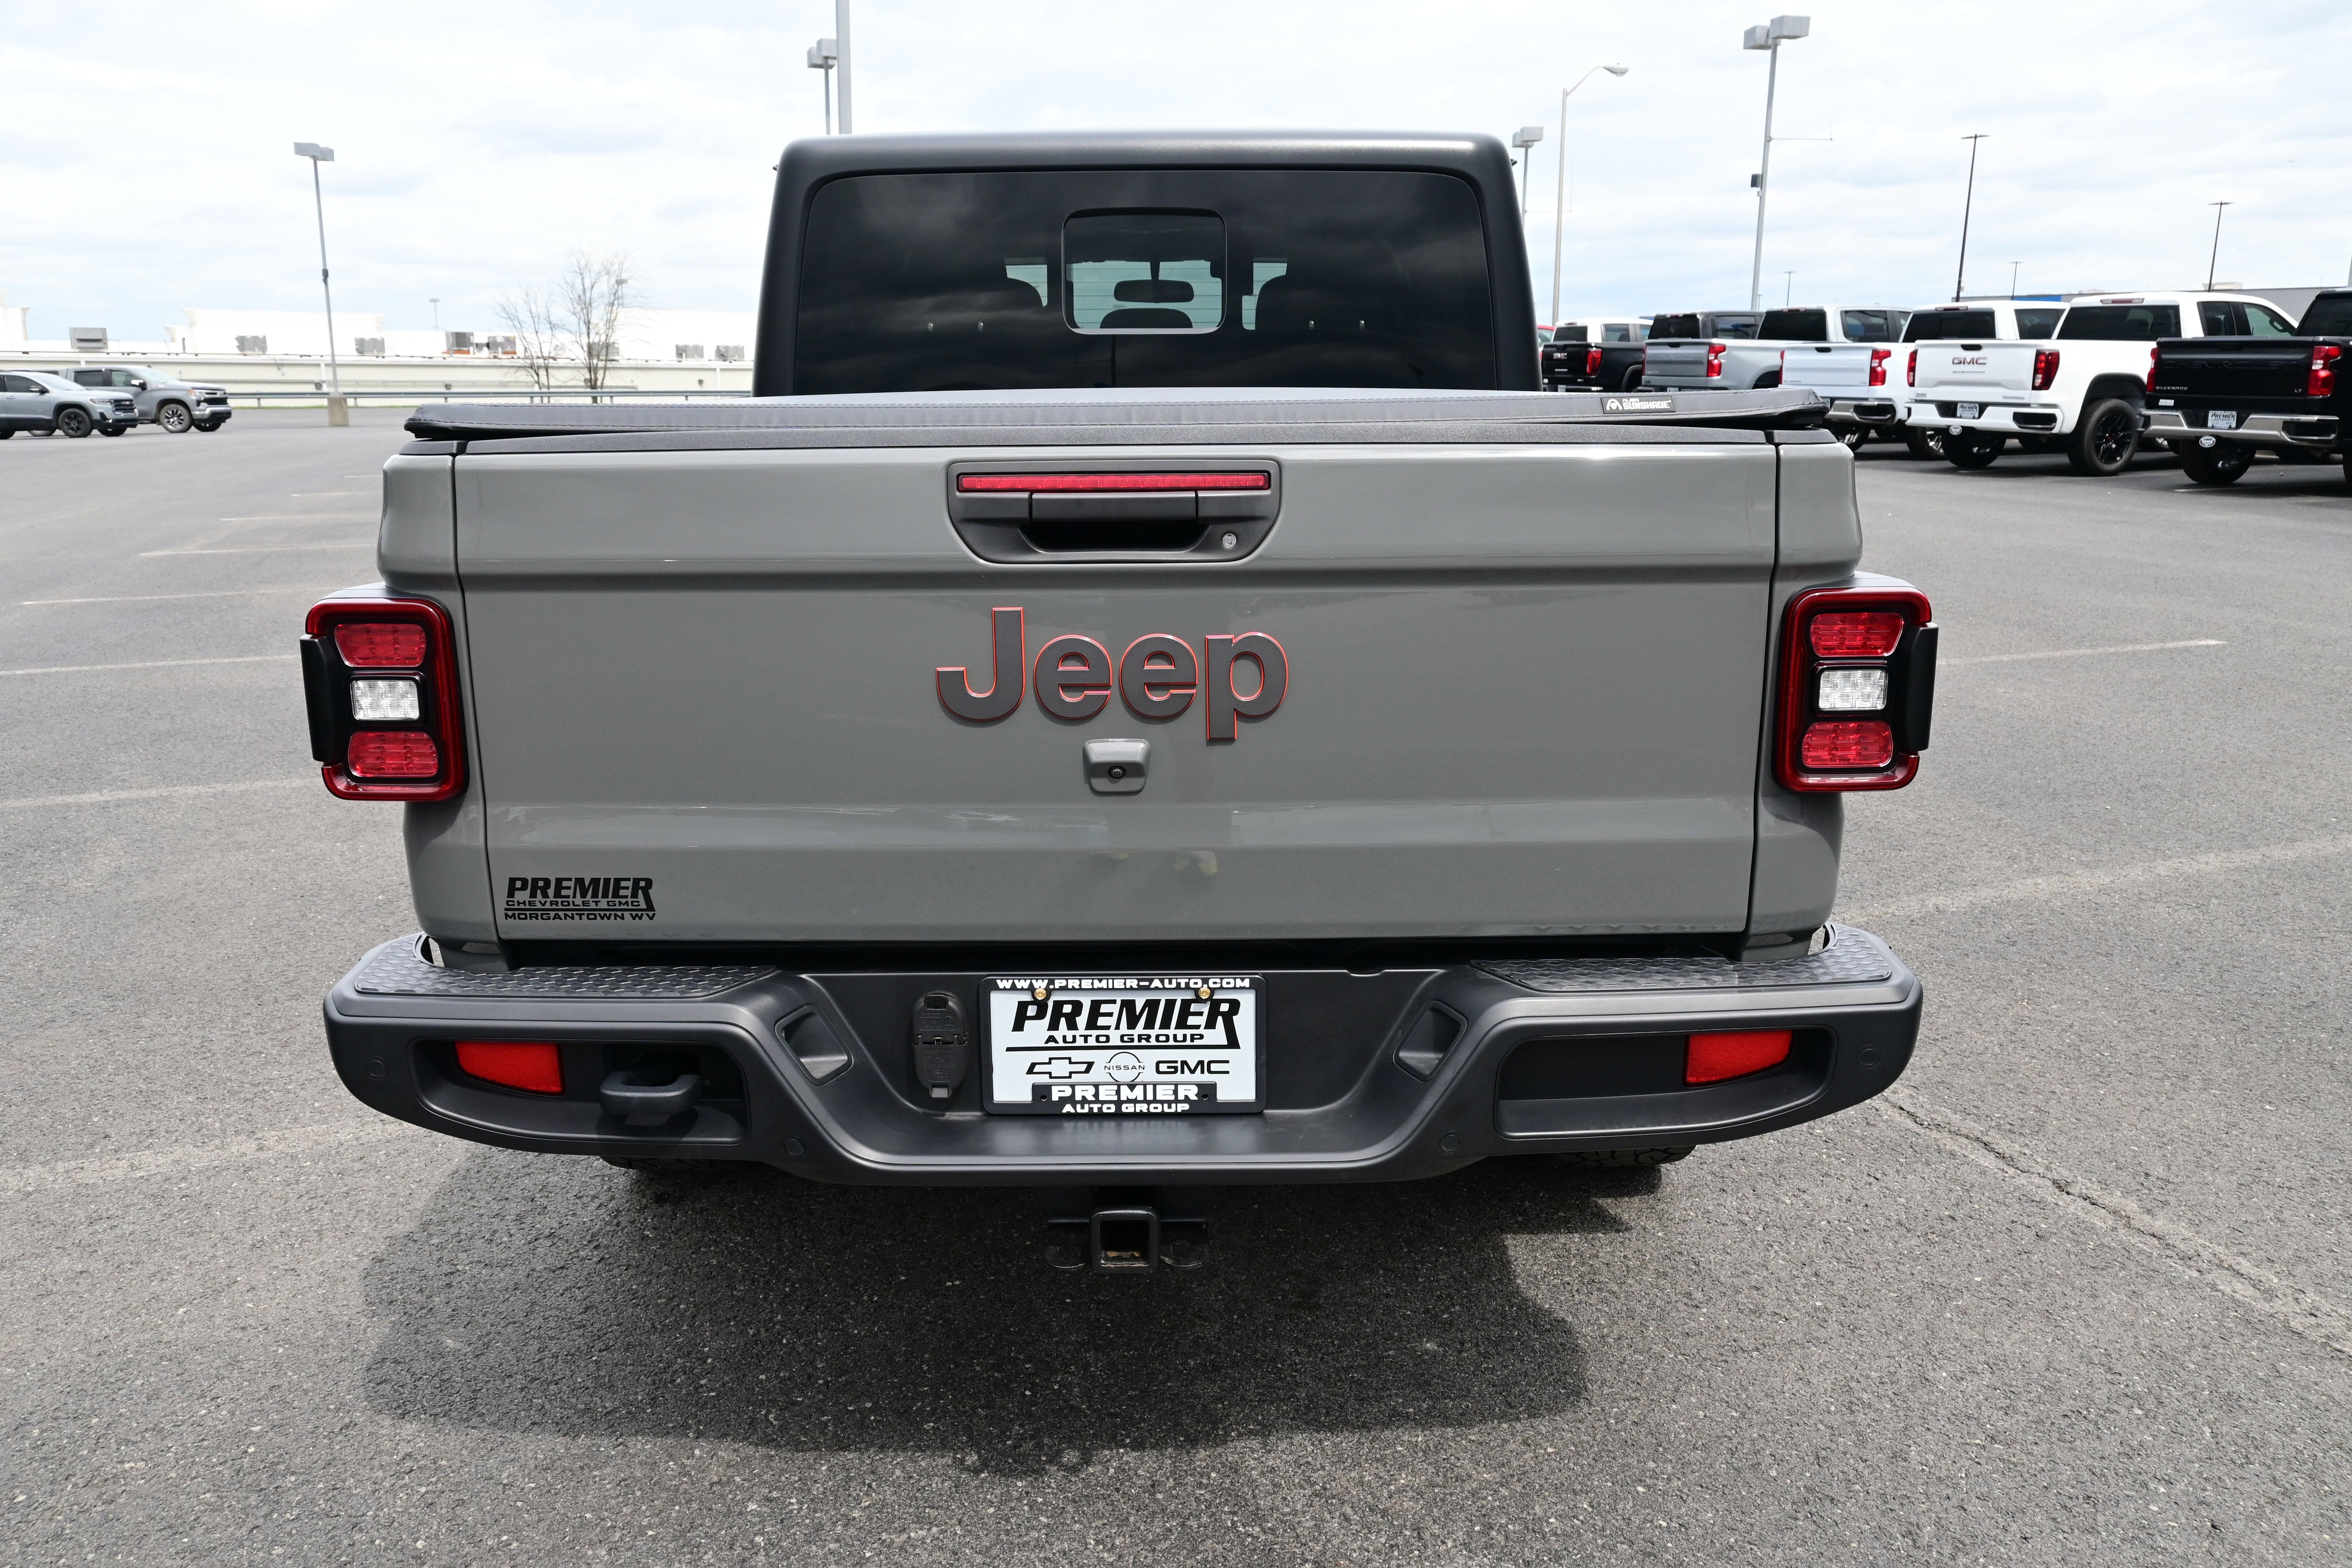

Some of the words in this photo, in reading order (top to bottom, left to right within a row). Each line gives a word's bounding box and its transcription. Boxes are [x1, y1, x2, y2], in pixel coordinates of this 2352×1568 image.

[1952, 357, 1987, 365] GMC
[1623, 401, 1670, 410] SUNSHADE
[936, 607, 1288, 740] Jeep
[506, 877, 653, 899] PREMIER
[504, 912, 625, 920] MORGANTOWN
[996, 978, 1250, 989] WWW.PREMIER-AUTO.COM
[1011, 998, 1241, 1033] PREMIER
[1044, 1034, 1110, 1044] AUTO
[1120, 1033, 1204, 1043] GROUP
[1155, 1060, 1230, 1075] GMC
[1051, 1084, 1198, 1101] PREMIER
[1062, 1104, 1116, 1113] AUTO
[1122, 1103, 1190, 1113] GROUP
